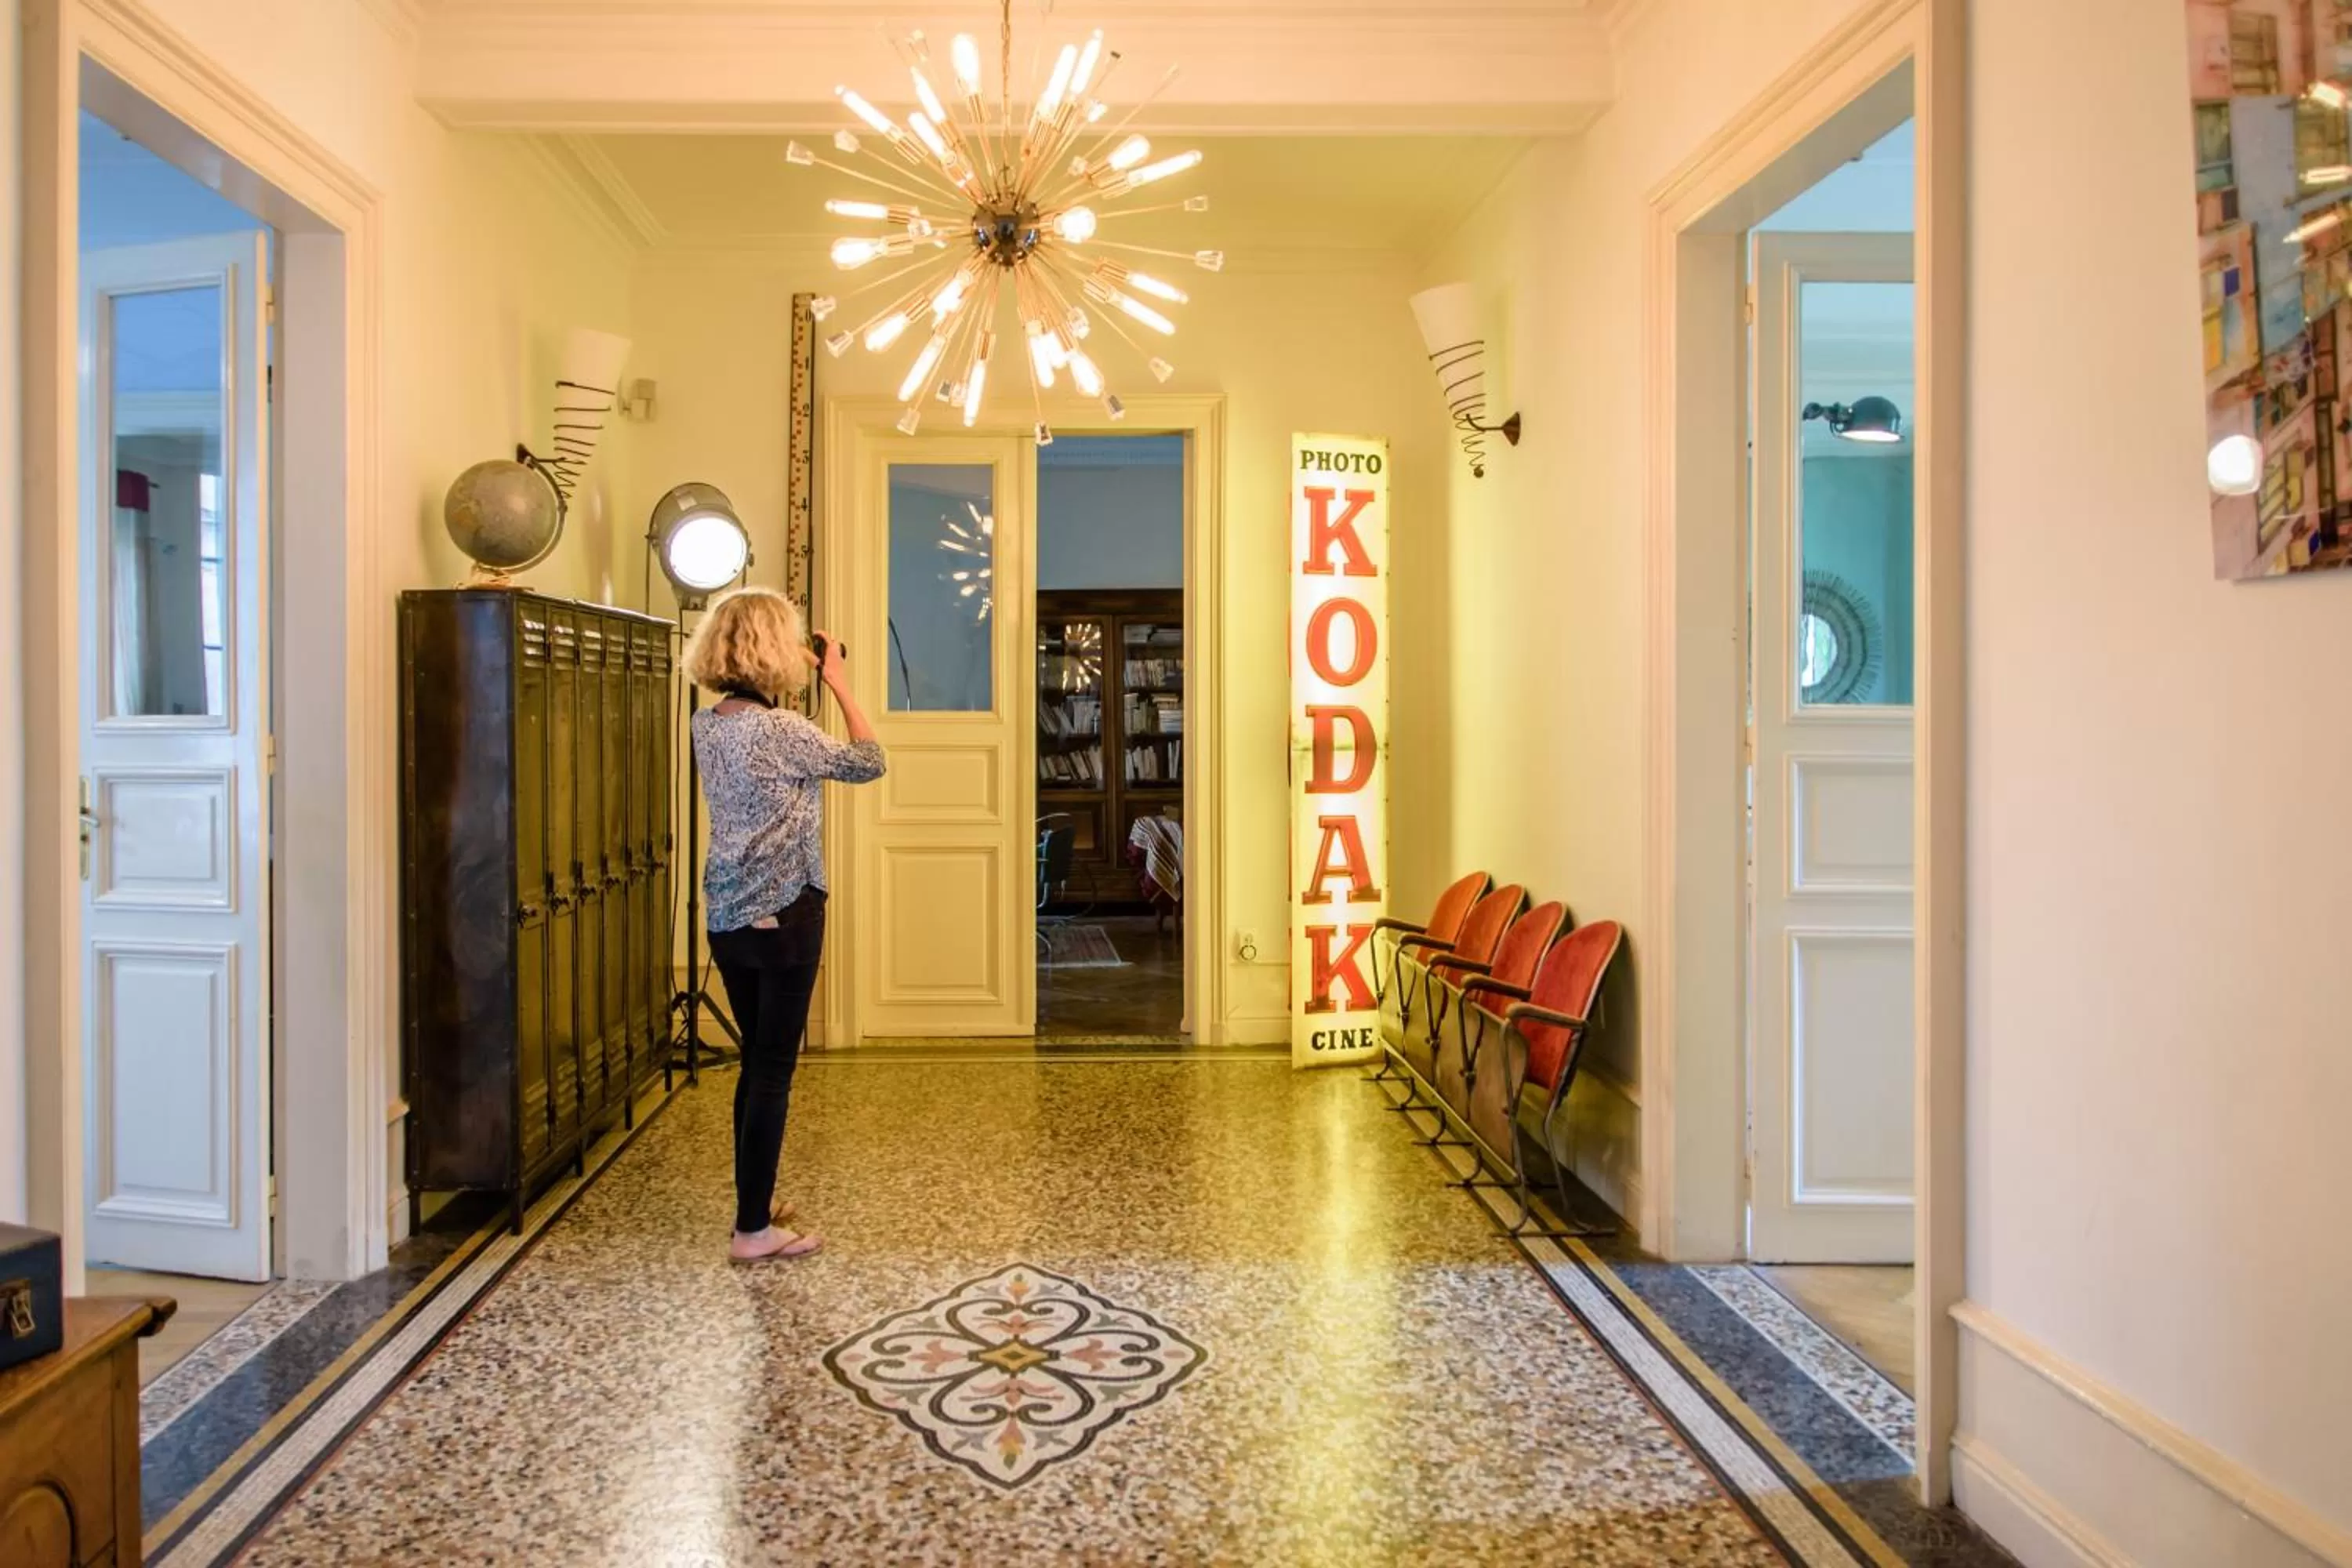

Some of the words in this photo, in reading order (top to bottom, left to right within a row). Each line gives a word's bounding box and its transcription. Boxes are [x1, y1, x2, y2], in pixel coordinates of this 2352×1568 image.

[803, 403, 810, 417] 2
[1300, 449, 1381, 474] PHOTO
[800, 497, 808, 511] 4
[1302, 486, 1381, 1014] KODAK
[1312, 1028, 1374, 1051] CINE
